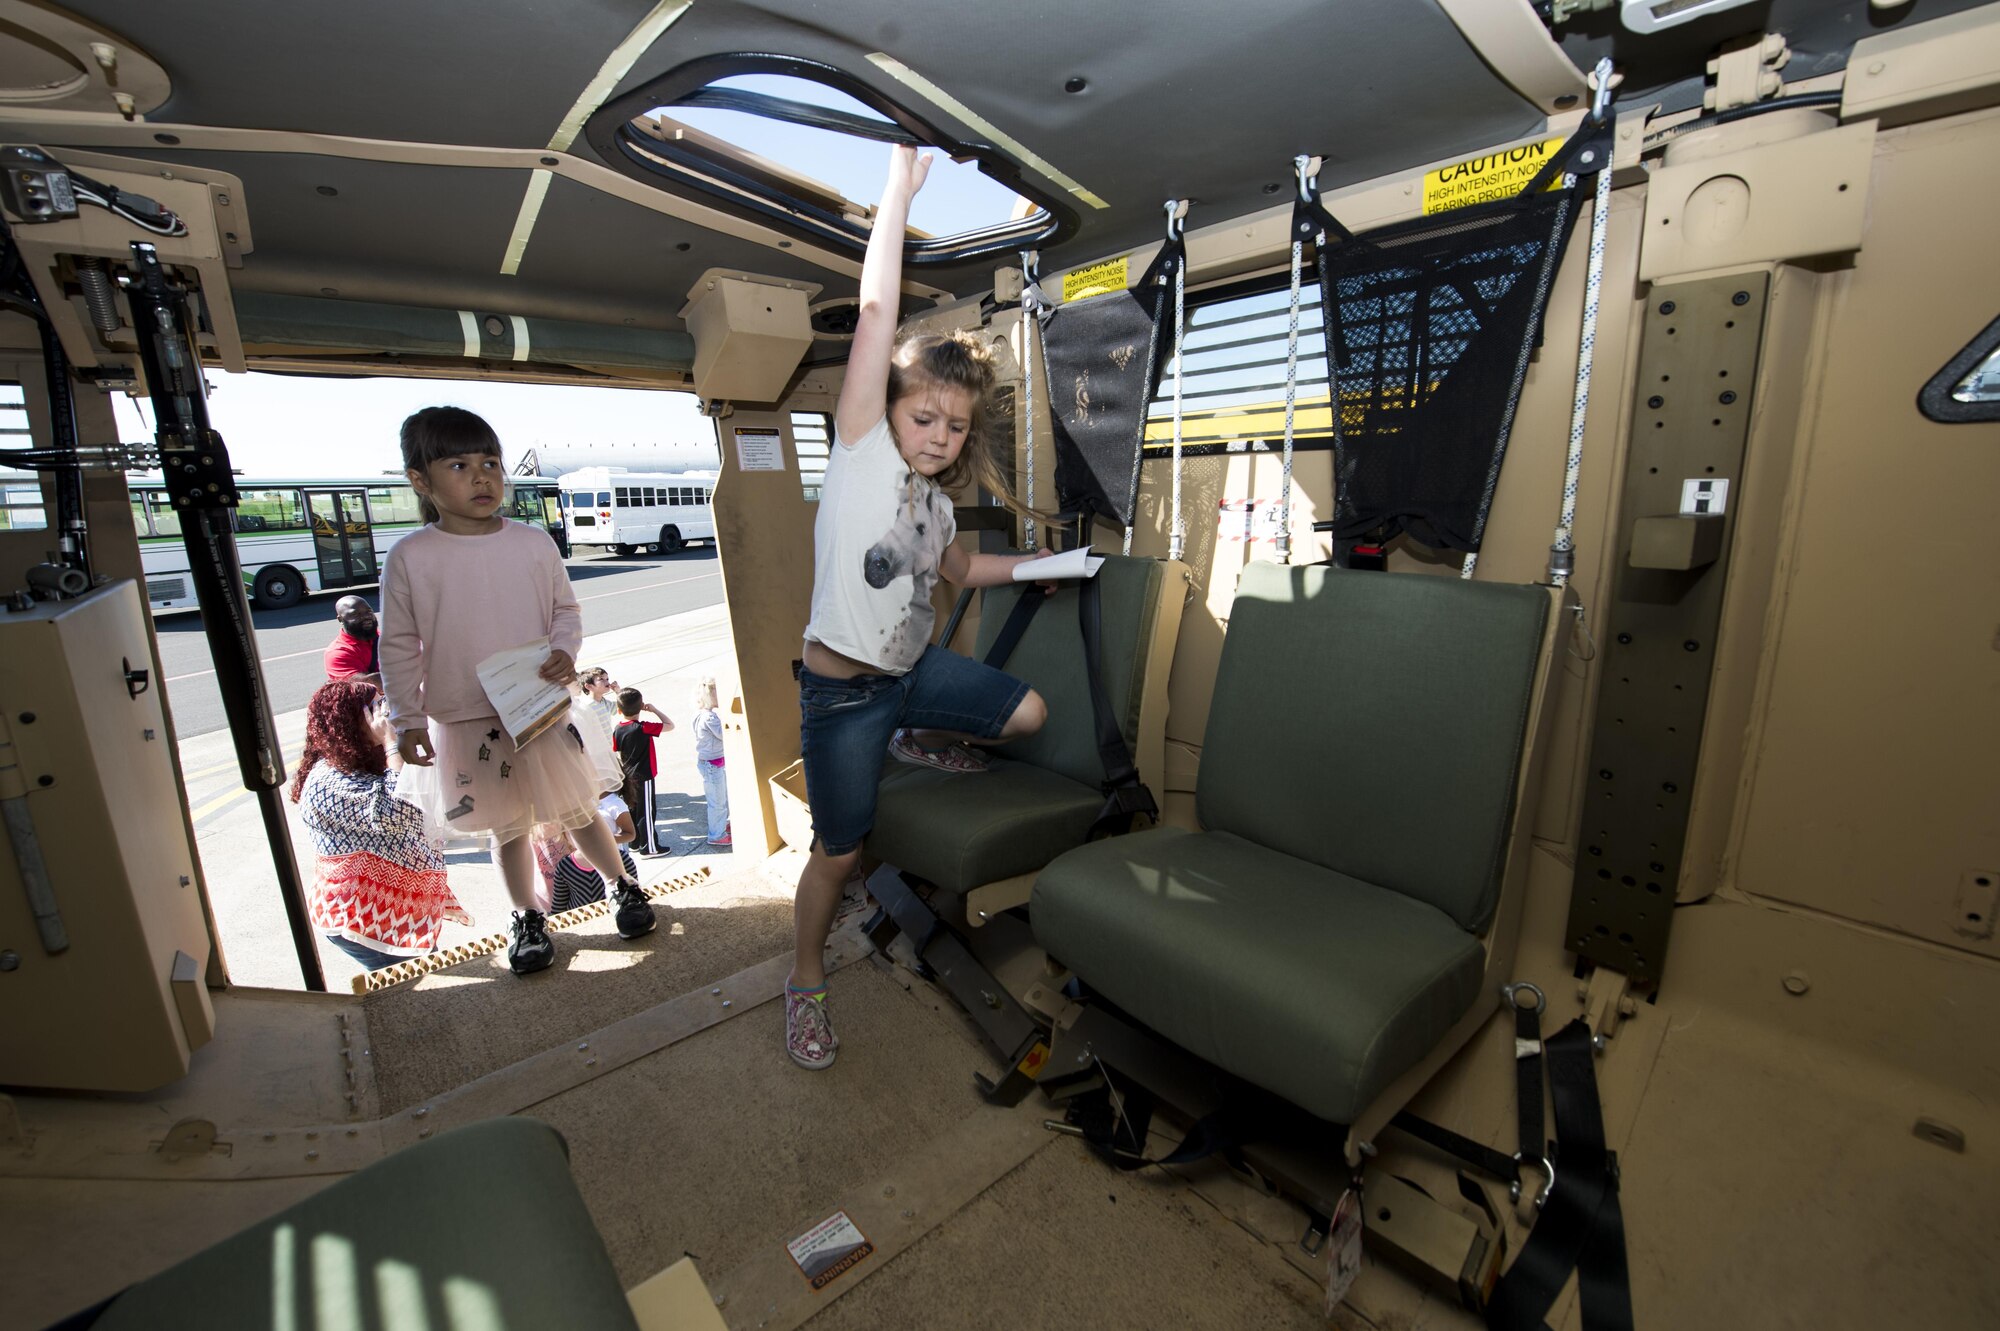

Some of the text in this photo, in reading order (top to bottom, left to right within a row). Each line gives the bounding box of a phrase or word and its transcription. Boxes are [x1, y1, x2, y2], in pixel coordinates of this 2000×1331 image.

[1439, 142, 1546, 183] CAUTION
[1428, 187, 1454, 202] HIGH
[1457, 168, 1515, 193] INTENSITY
[1428, 194, 1476, 215] HEARING
[1065, 280, 1078, 289] HIGH
[1080, 271, 1105, 284] INTENSITY
[1106, 264, 1124, 276] NOISE
[815, 1246, 870, 1287] WARNING
